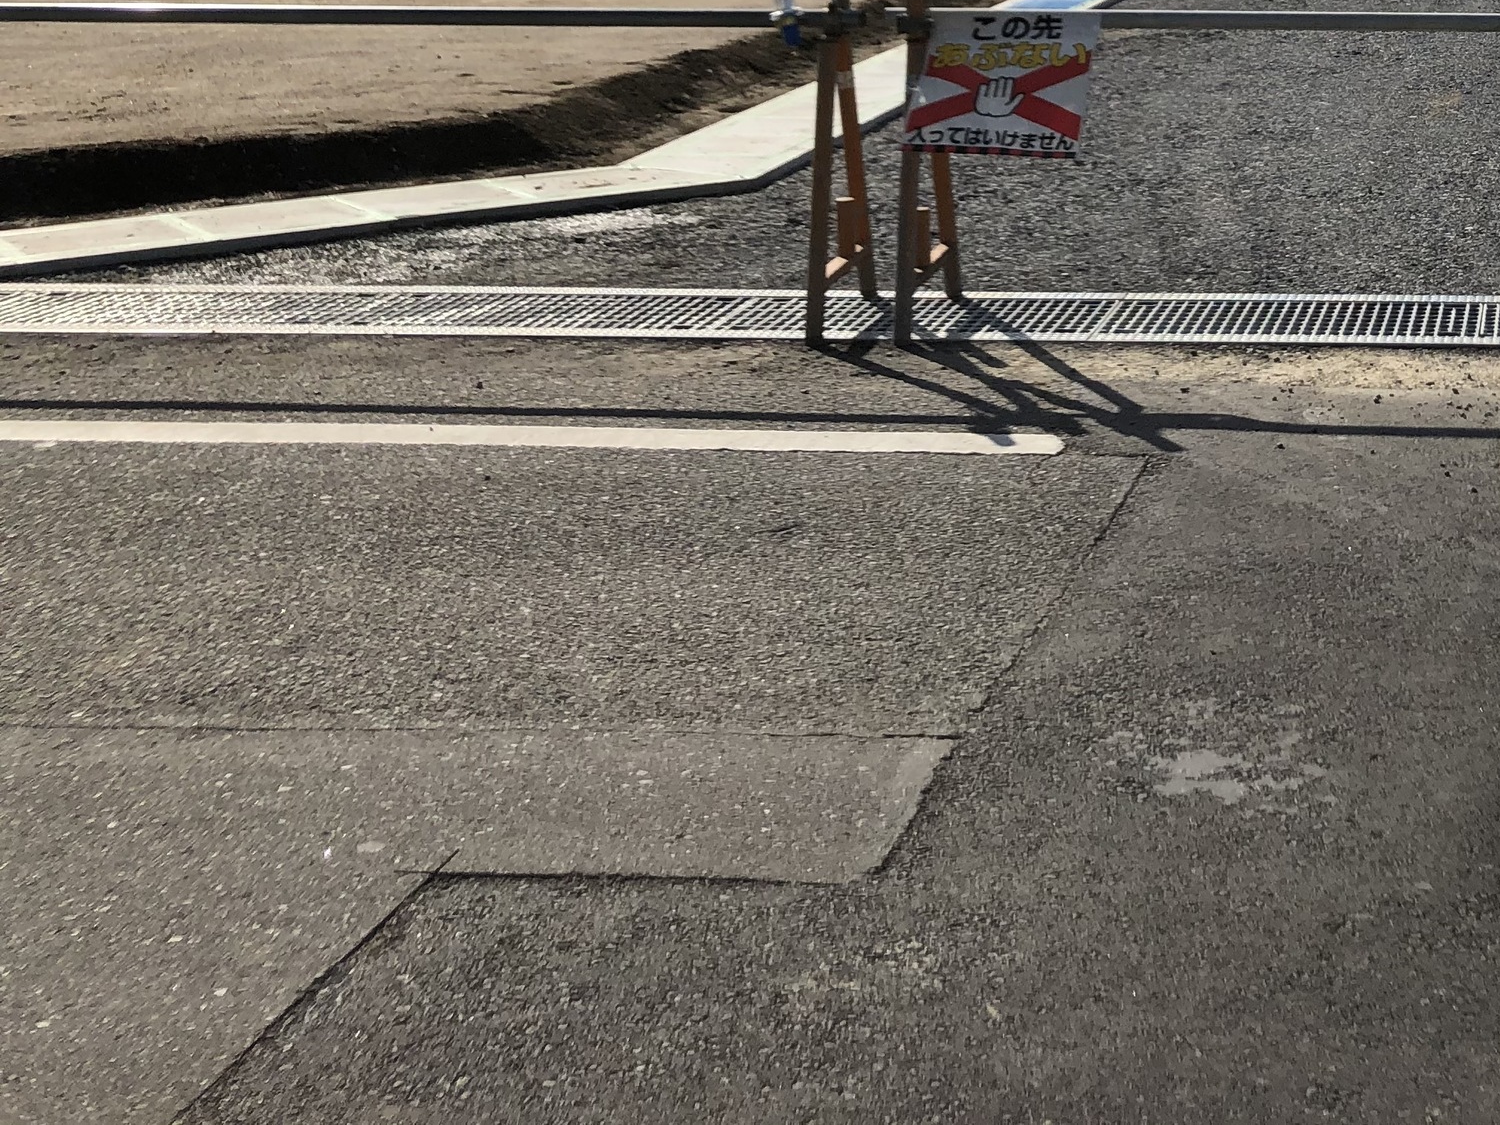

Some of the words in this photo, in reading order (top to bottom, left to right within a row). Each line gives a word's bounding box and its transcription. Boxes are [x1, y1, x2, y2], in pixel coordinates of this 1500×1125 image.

[973, 15, 1063, 40] この先
[932, 42, 1087, 71] あぶない
[908, 127, 1075, 152] 入ってはいけません
